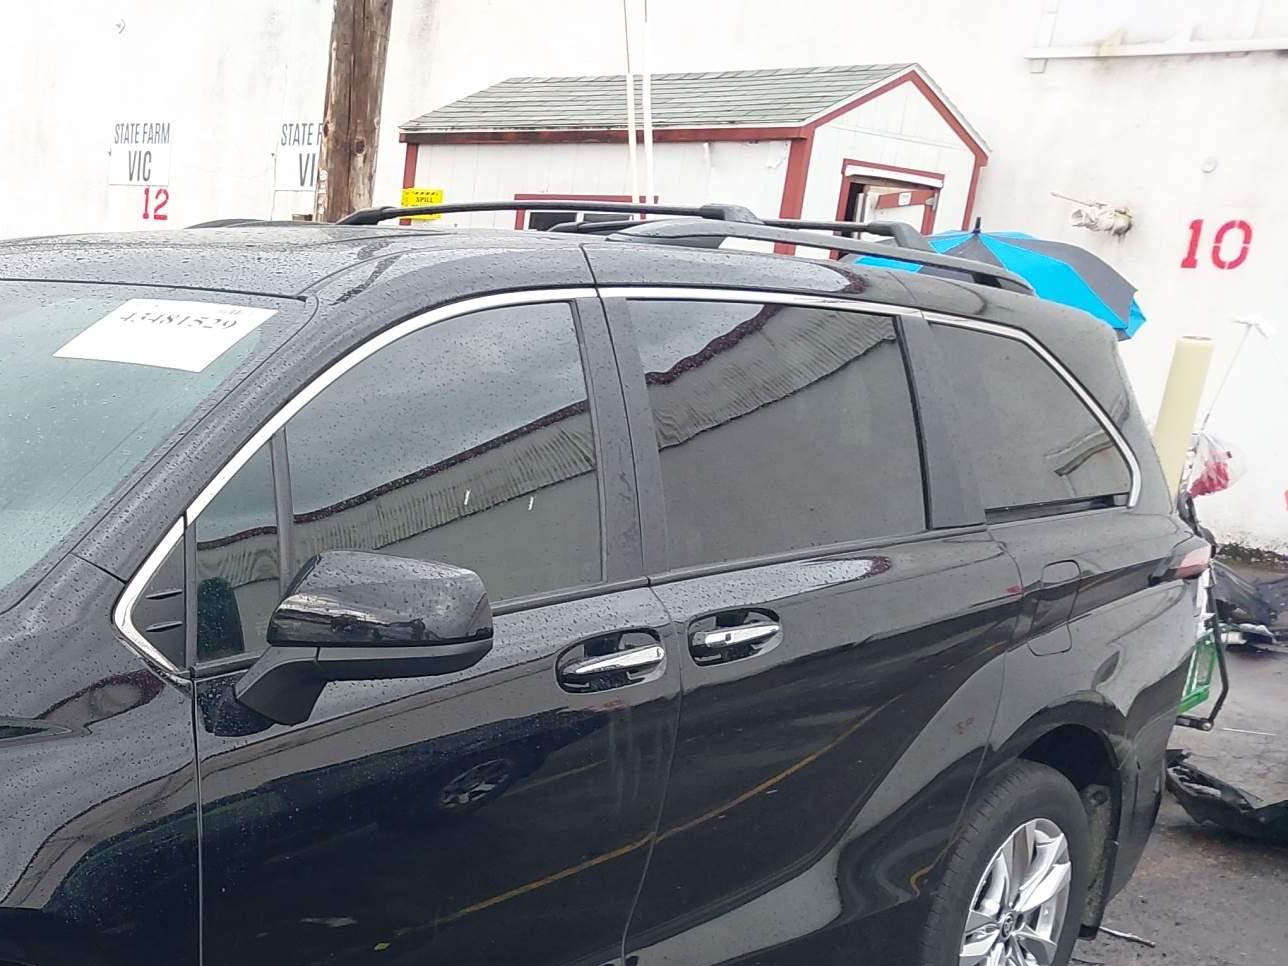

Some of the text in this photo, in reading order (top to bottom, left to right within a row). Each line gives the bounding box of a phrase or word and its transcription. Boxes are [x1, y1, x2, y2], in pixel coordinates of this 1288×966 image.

[114, 122, 170, 144] STATE FARM
[281, 123, 314, 146] STATE
[128, 150, 152, 182] VIC
[298, 153, 316, 187] VI
[142, 187, 170, 221] 12
[1180, 219, 1253, 270] 10
